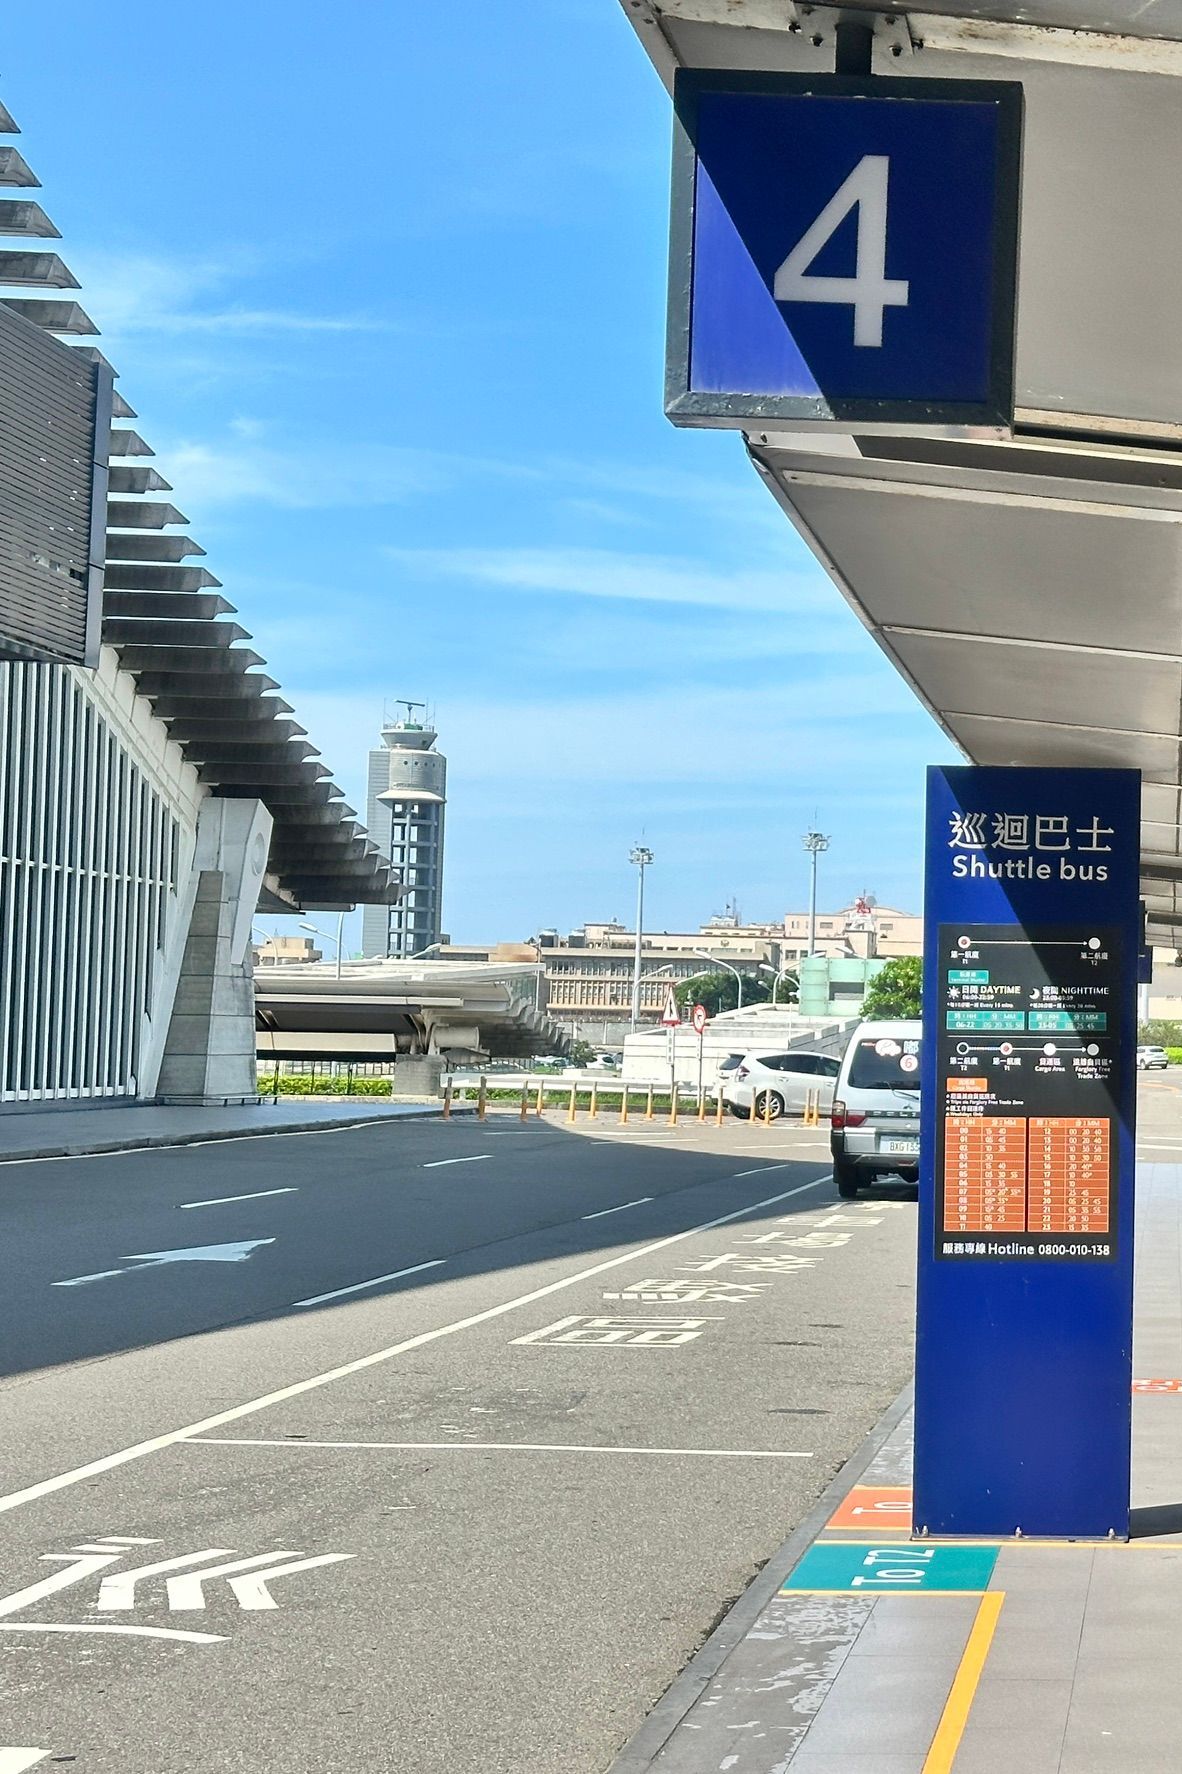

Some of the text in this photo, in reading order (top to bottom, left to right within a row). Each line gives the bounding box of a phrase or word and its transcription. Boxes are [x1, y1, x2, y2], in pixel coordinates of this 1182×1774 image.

[773, 155, 910, 348] 4
[948, 811, 1115, 851] 巡迴巴士
[952, 855, 1108, 881] Shuttle bus
[980, 986, 1021, 994] DAYTIME
[1061, 987, 1109, 995] NIGHTTIME
[905, 1057, 912, 1068] 6
[942, 1242, 1110, 1255] 服務專線 Hotline 0800-010-138
[852, 1501, 913, 1514] To
[851, 1549, 935, 1586] To T2
